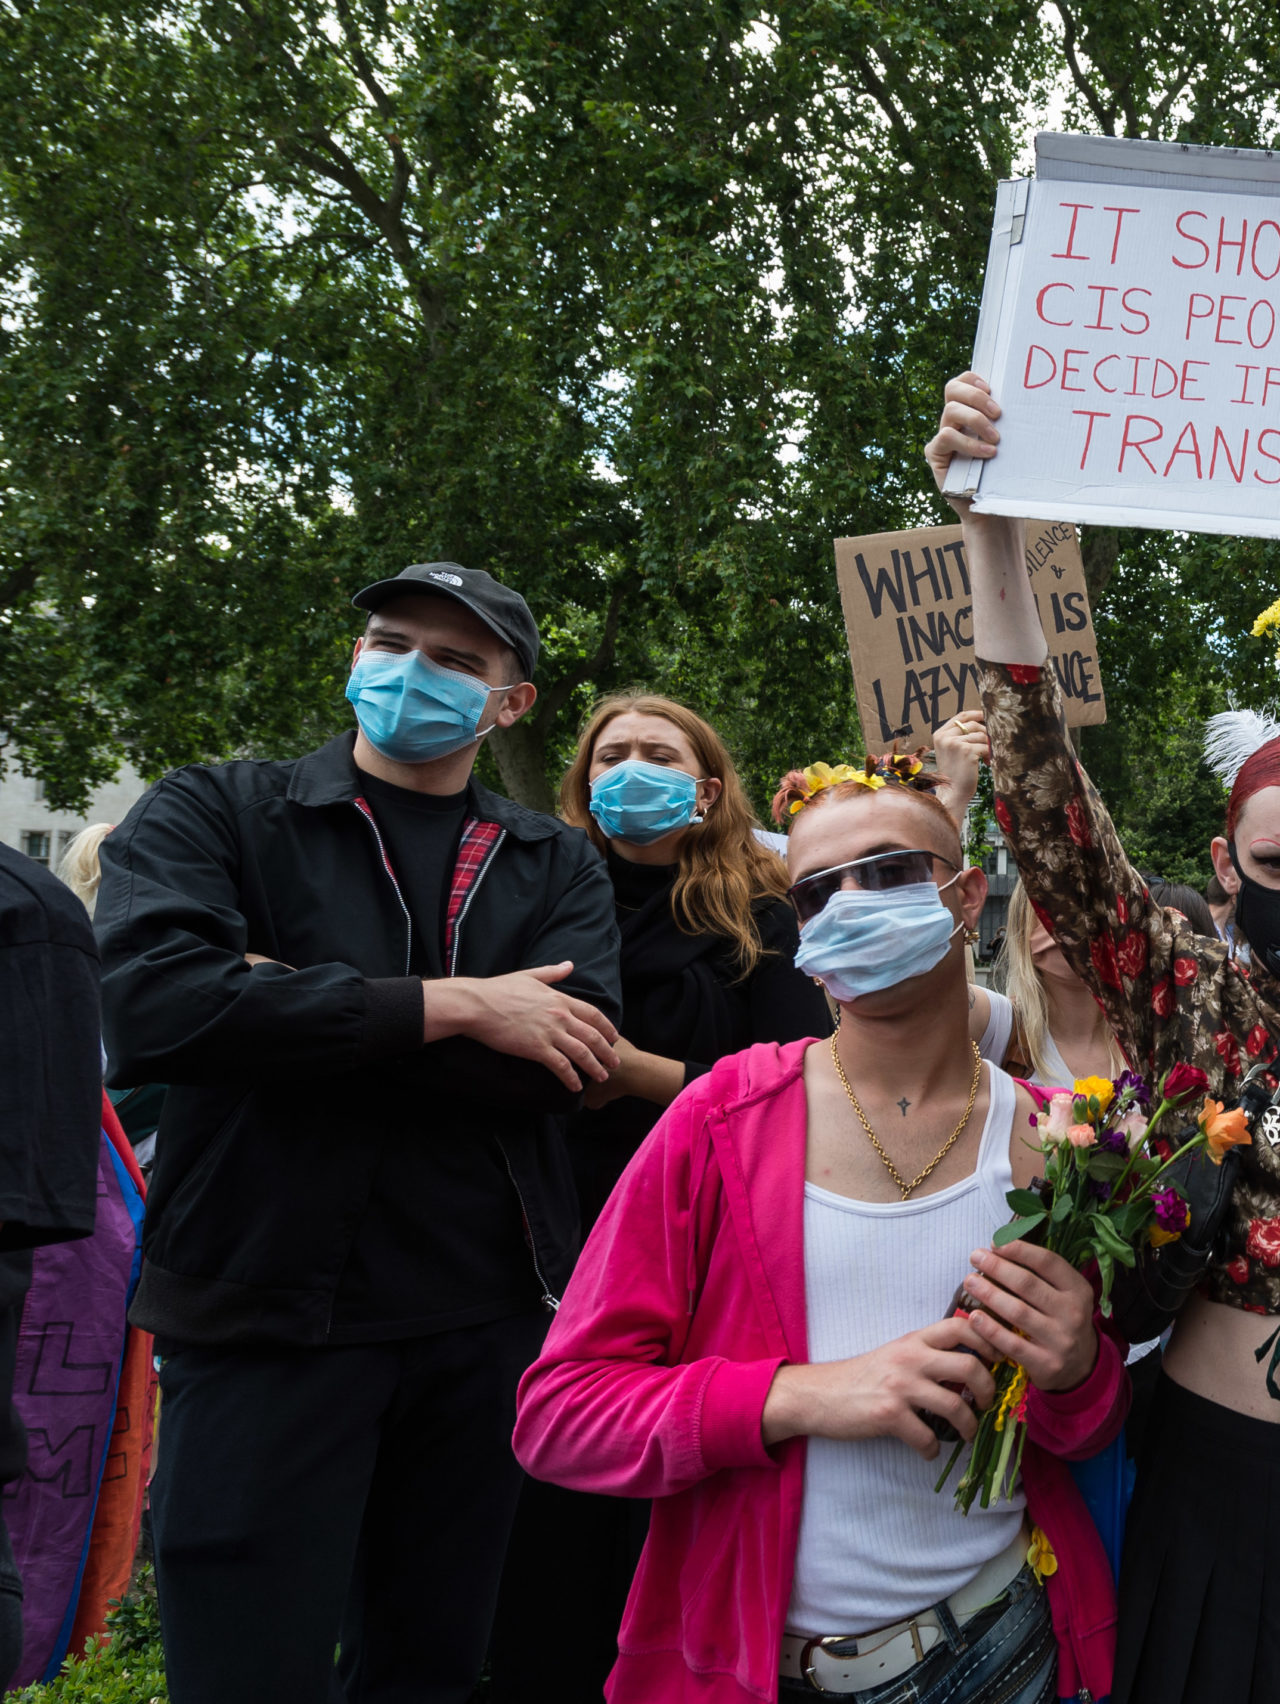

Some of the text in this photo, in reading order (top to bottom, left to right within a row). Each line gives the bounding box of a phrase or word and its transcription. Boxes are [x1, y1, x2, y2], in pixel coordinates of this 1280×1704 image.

[1051, 202, 1140, 264] IT
[1036, 282, 1152, 335] CIS
[1023, 345, 1210, 401] DECIDE
[854, 540, 971, 619] WHIT
[1050, 592, 1088, 634] IS
[872, 662, 969, 743] LAZY
